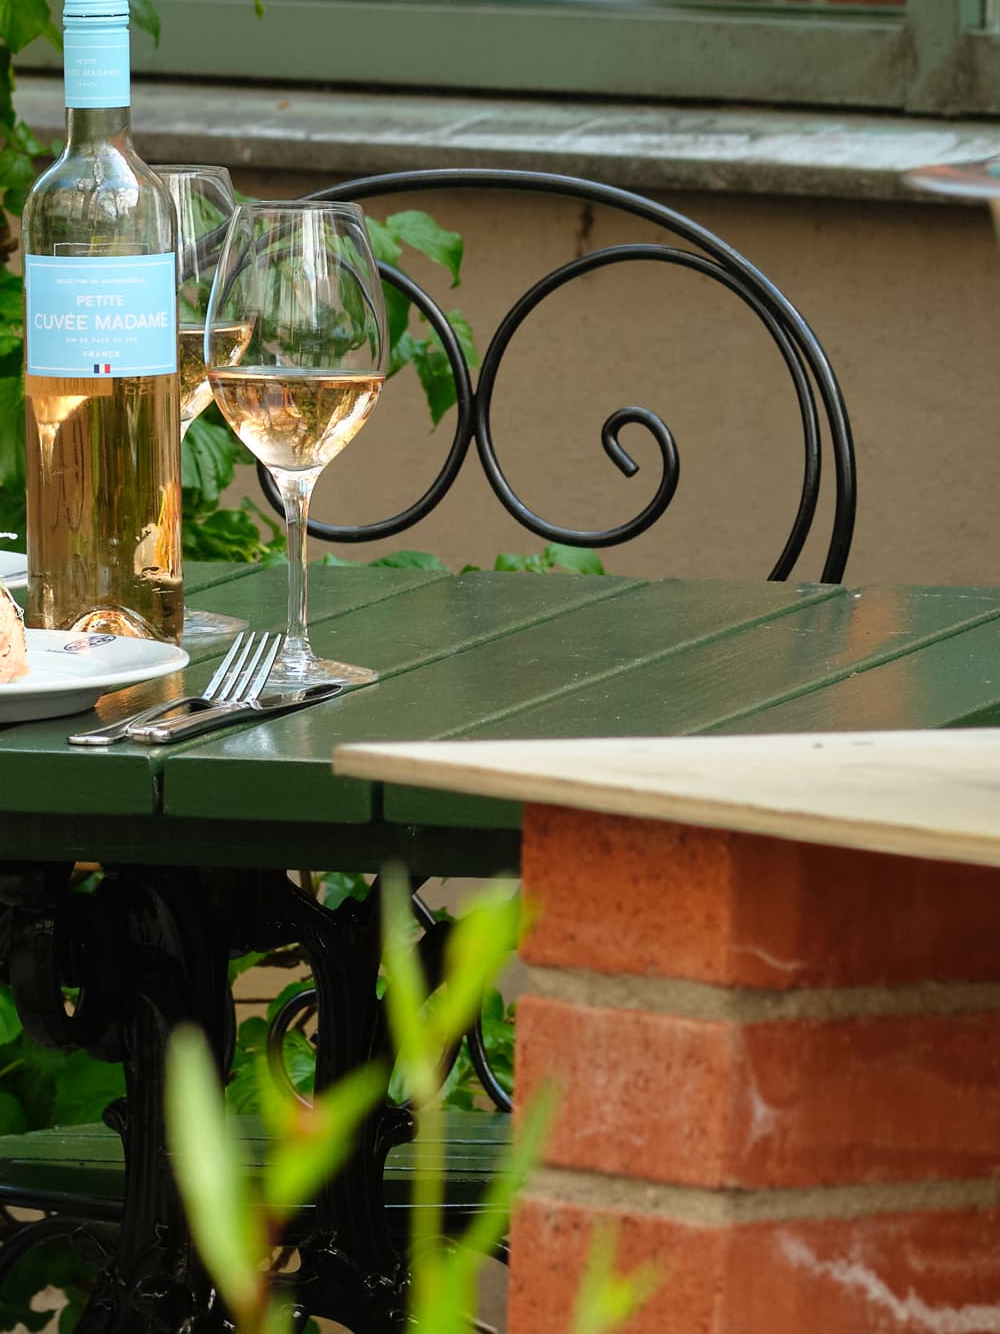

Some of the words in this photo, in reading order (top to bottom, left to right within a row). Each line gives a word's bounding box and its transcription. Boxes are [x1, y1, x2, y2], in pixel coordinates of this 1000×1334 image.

[77, 295, 125, 307] PETITE
[34, 312, 88, 330] CUVÉE
[95, 311, 168, 330] MADAME
